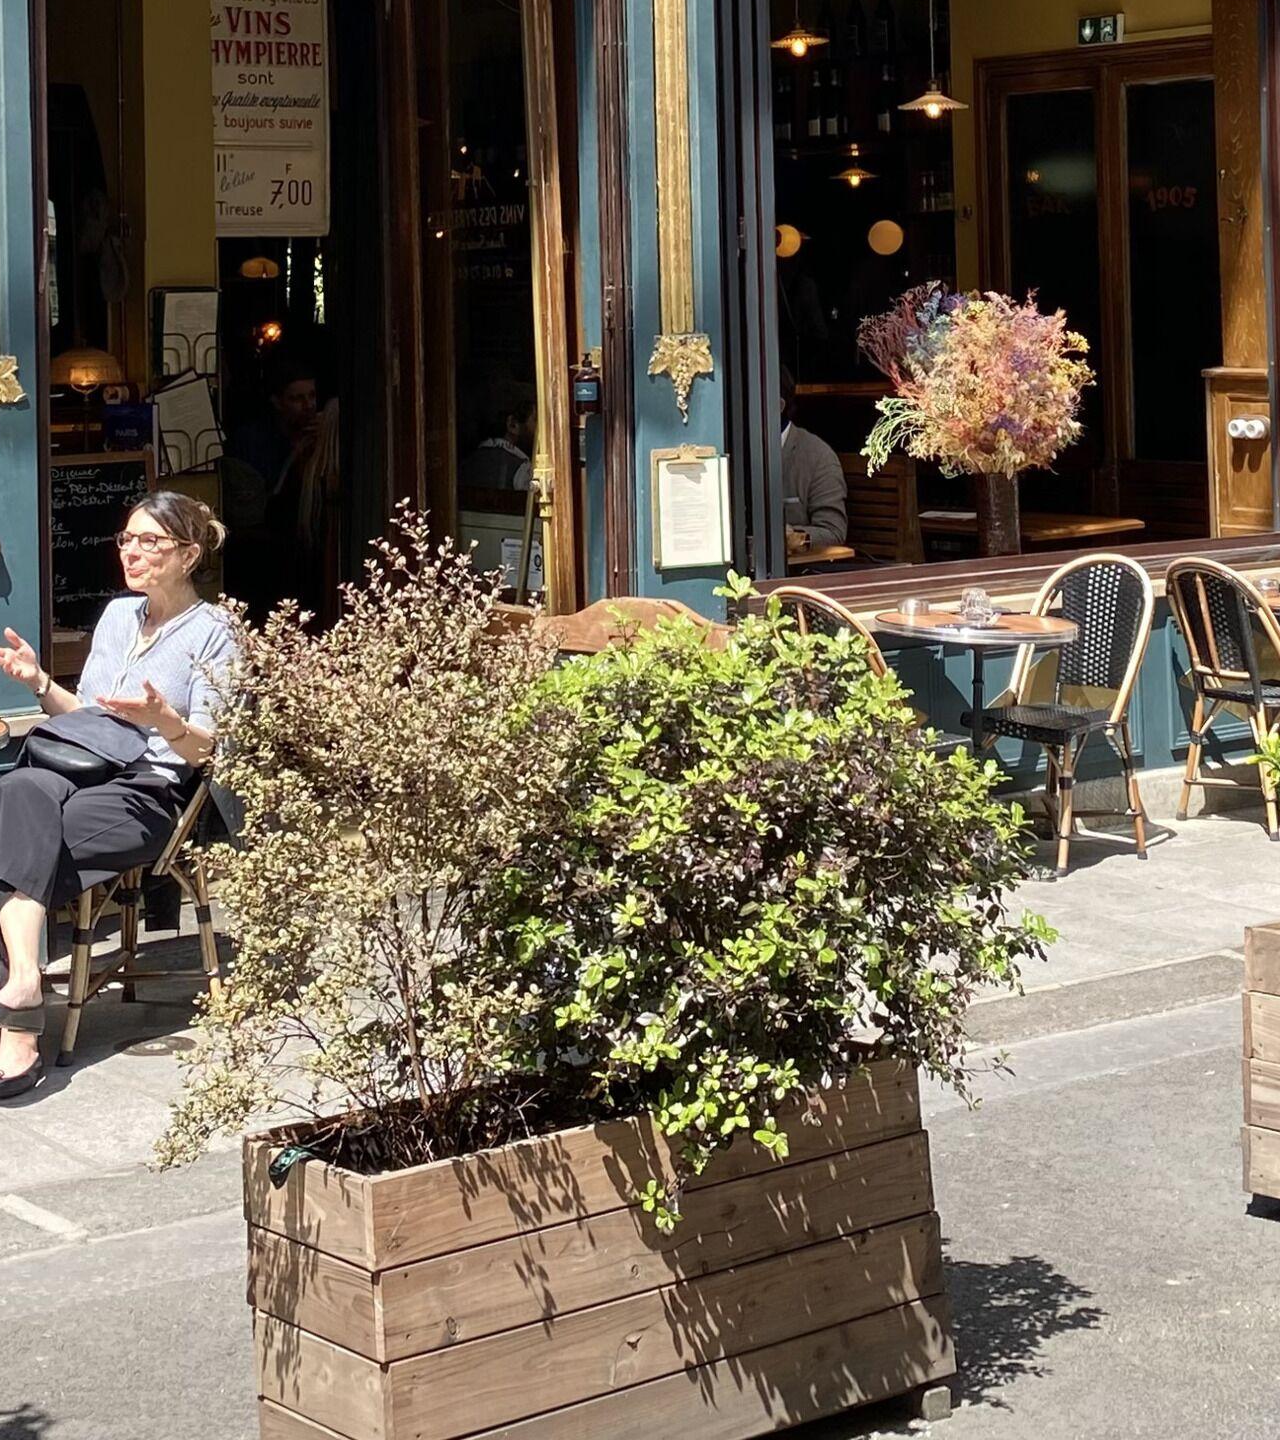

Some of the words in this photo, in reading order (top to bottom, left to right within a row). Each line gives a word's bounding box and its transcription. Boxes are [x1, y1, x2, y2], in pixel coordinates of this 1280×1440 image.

[224, 6, 291, 35] VINS
[237, 71, 274, 85] sont
[224, 115, 275, 132] toujours
[279, 117, 313, 129] suivie
[285, 163, 293, 175] F
[270, 179, 312, 209] 7,00
[1147, 185, 1198, 214] 1905
[216, 201, 263, 216] Tireuse
